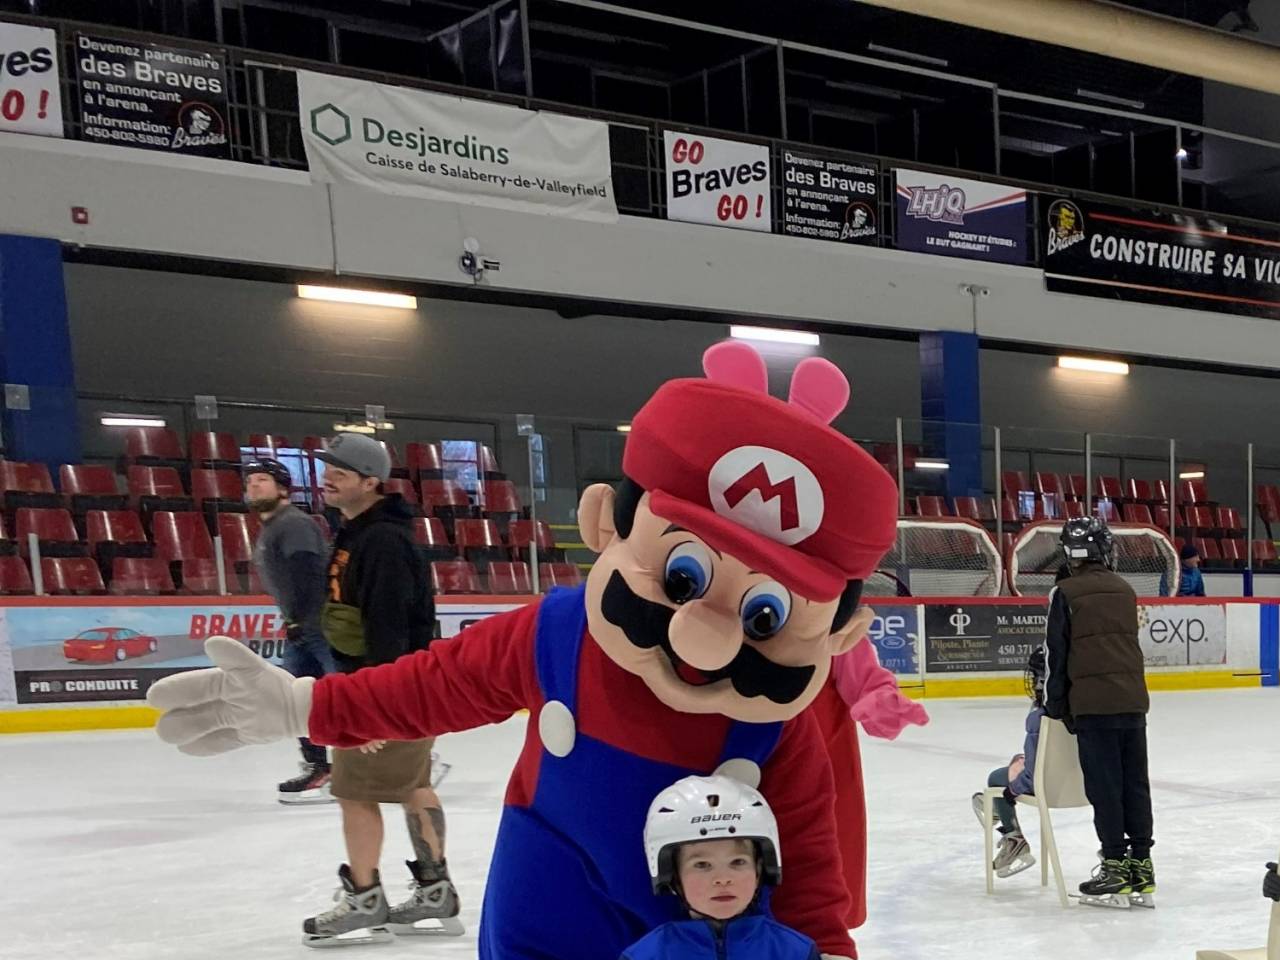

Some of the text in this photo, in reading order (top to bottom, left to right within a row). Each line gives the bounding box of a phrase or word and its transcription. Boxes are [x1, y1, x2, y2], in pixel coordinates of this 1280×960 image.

[79, 36, 219, 70] Devenez partenaire
[81, 54, 222, 93] des Braves
[83, 79, 182, 103] en annonçant
[84, 92, 94, 104] à
[84, 112, 171, 135] Information:
[363, 118, 509, 165] Desjardins
[672, 138, 704, 165] GO
[366, 152, 607, 198] Caisse de Salaberry-de-Valleyfield
[785, 152, 875, 176] Devenez partenaire
[672, 160, 767, 198] Braves
[786, 167, 875, 195] des Braves
[717, 194, 748, 221] GO
[926, 237, 935, 245] LE
[936, 238, 950, 247] BUT
[948, 231, 977, 243] HOCKEY
[978, 235, 987, 243] ET
[1048, 227, 1085, 256] Braves
[1090, 233, 1215, 275] CONSTRUIRE
[1223, 253, 1247, 279] SA
[723, 462, 800, 532] M
[998, 644, 1015, 655] 450
[1017, 644, 1033, 655] 371
[1150, 618, 1208, 664] exp.
[65, 679, 139, 692] CONDUITE
